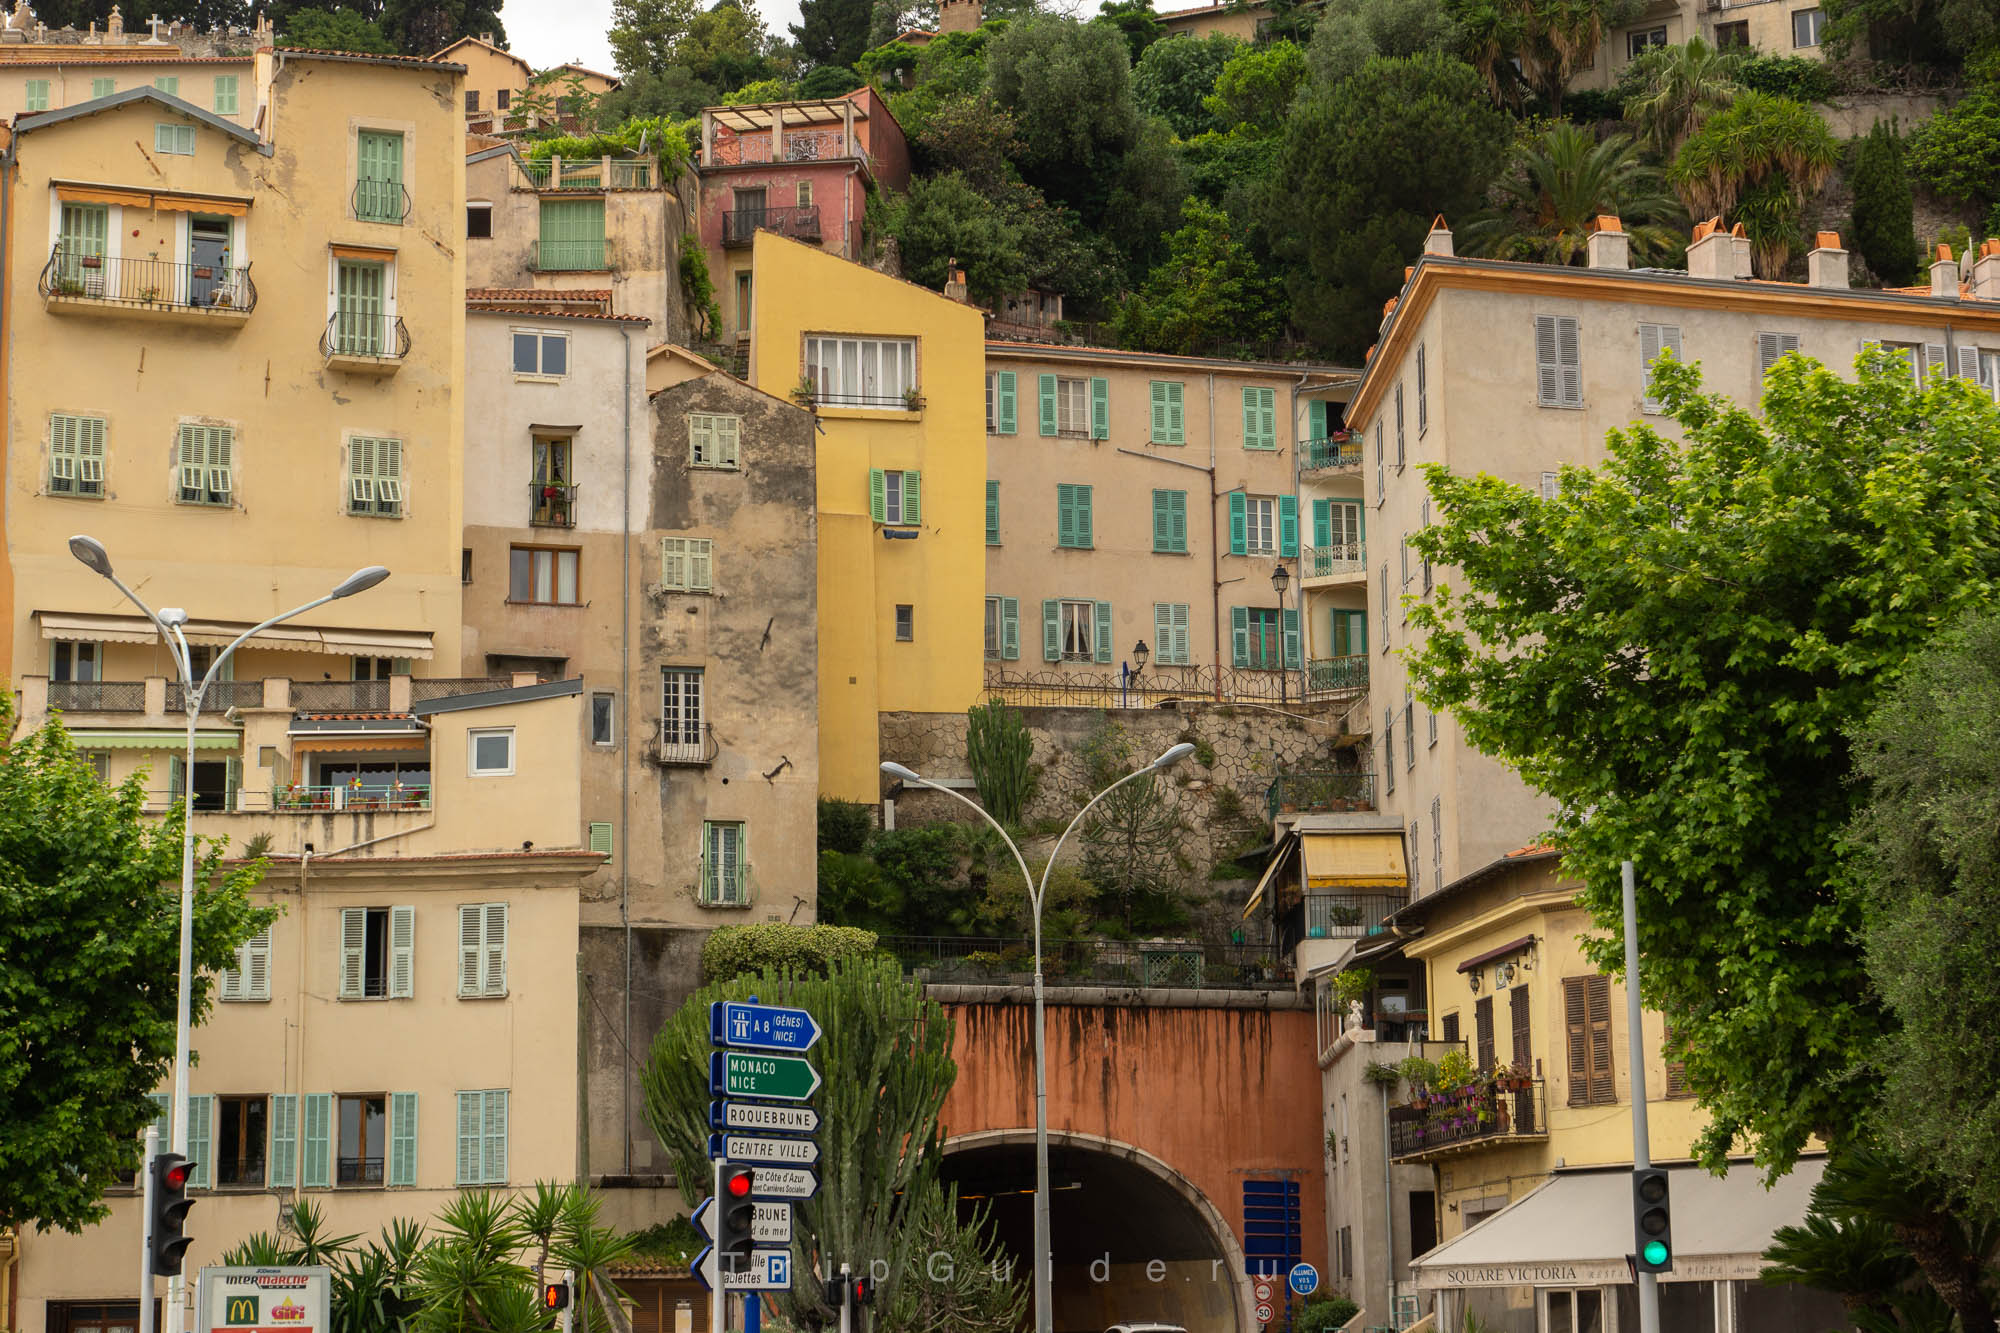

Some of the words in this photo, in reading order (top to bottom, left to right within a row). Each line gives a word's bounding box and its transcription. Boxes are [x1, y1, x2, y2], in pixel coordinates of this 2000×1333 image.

[754, 1019, 760, 1032] A
[763, 1020, 770, 1033] 8
[772, 1014, 804, 1028] (GÊNES)
[772, 1031, 796, 1042] (NICE)
[730, 1059, 776, 1075] MONACO
[730, 1075, 756, 1090] NICE
[730, 1109, 810, 1126] ROQUEBRUNE
[731, 1142, 773, 1156] CENTRE
[780, 1144, 809, 1158] VILLE
[765, 1171, 782, 1182] Côte
[783, 1172, 805, 1183] d'Azur
[751, 1208, 787, 1221] BRUNE
[760, 1225, 769, 1235] de
[772, 1228, 787, 1236] mer
[751, 1254, 765, 1267] ille
[771, 1258, 782, 1281] P
[1447, 1268, 1505, 1285] SQUARE
[1508, 1263, 1577, 1281] VICTORIA
[724, 1272, 761, 1284] ablettes
[1258, 1308, 1270, 1318] 50
